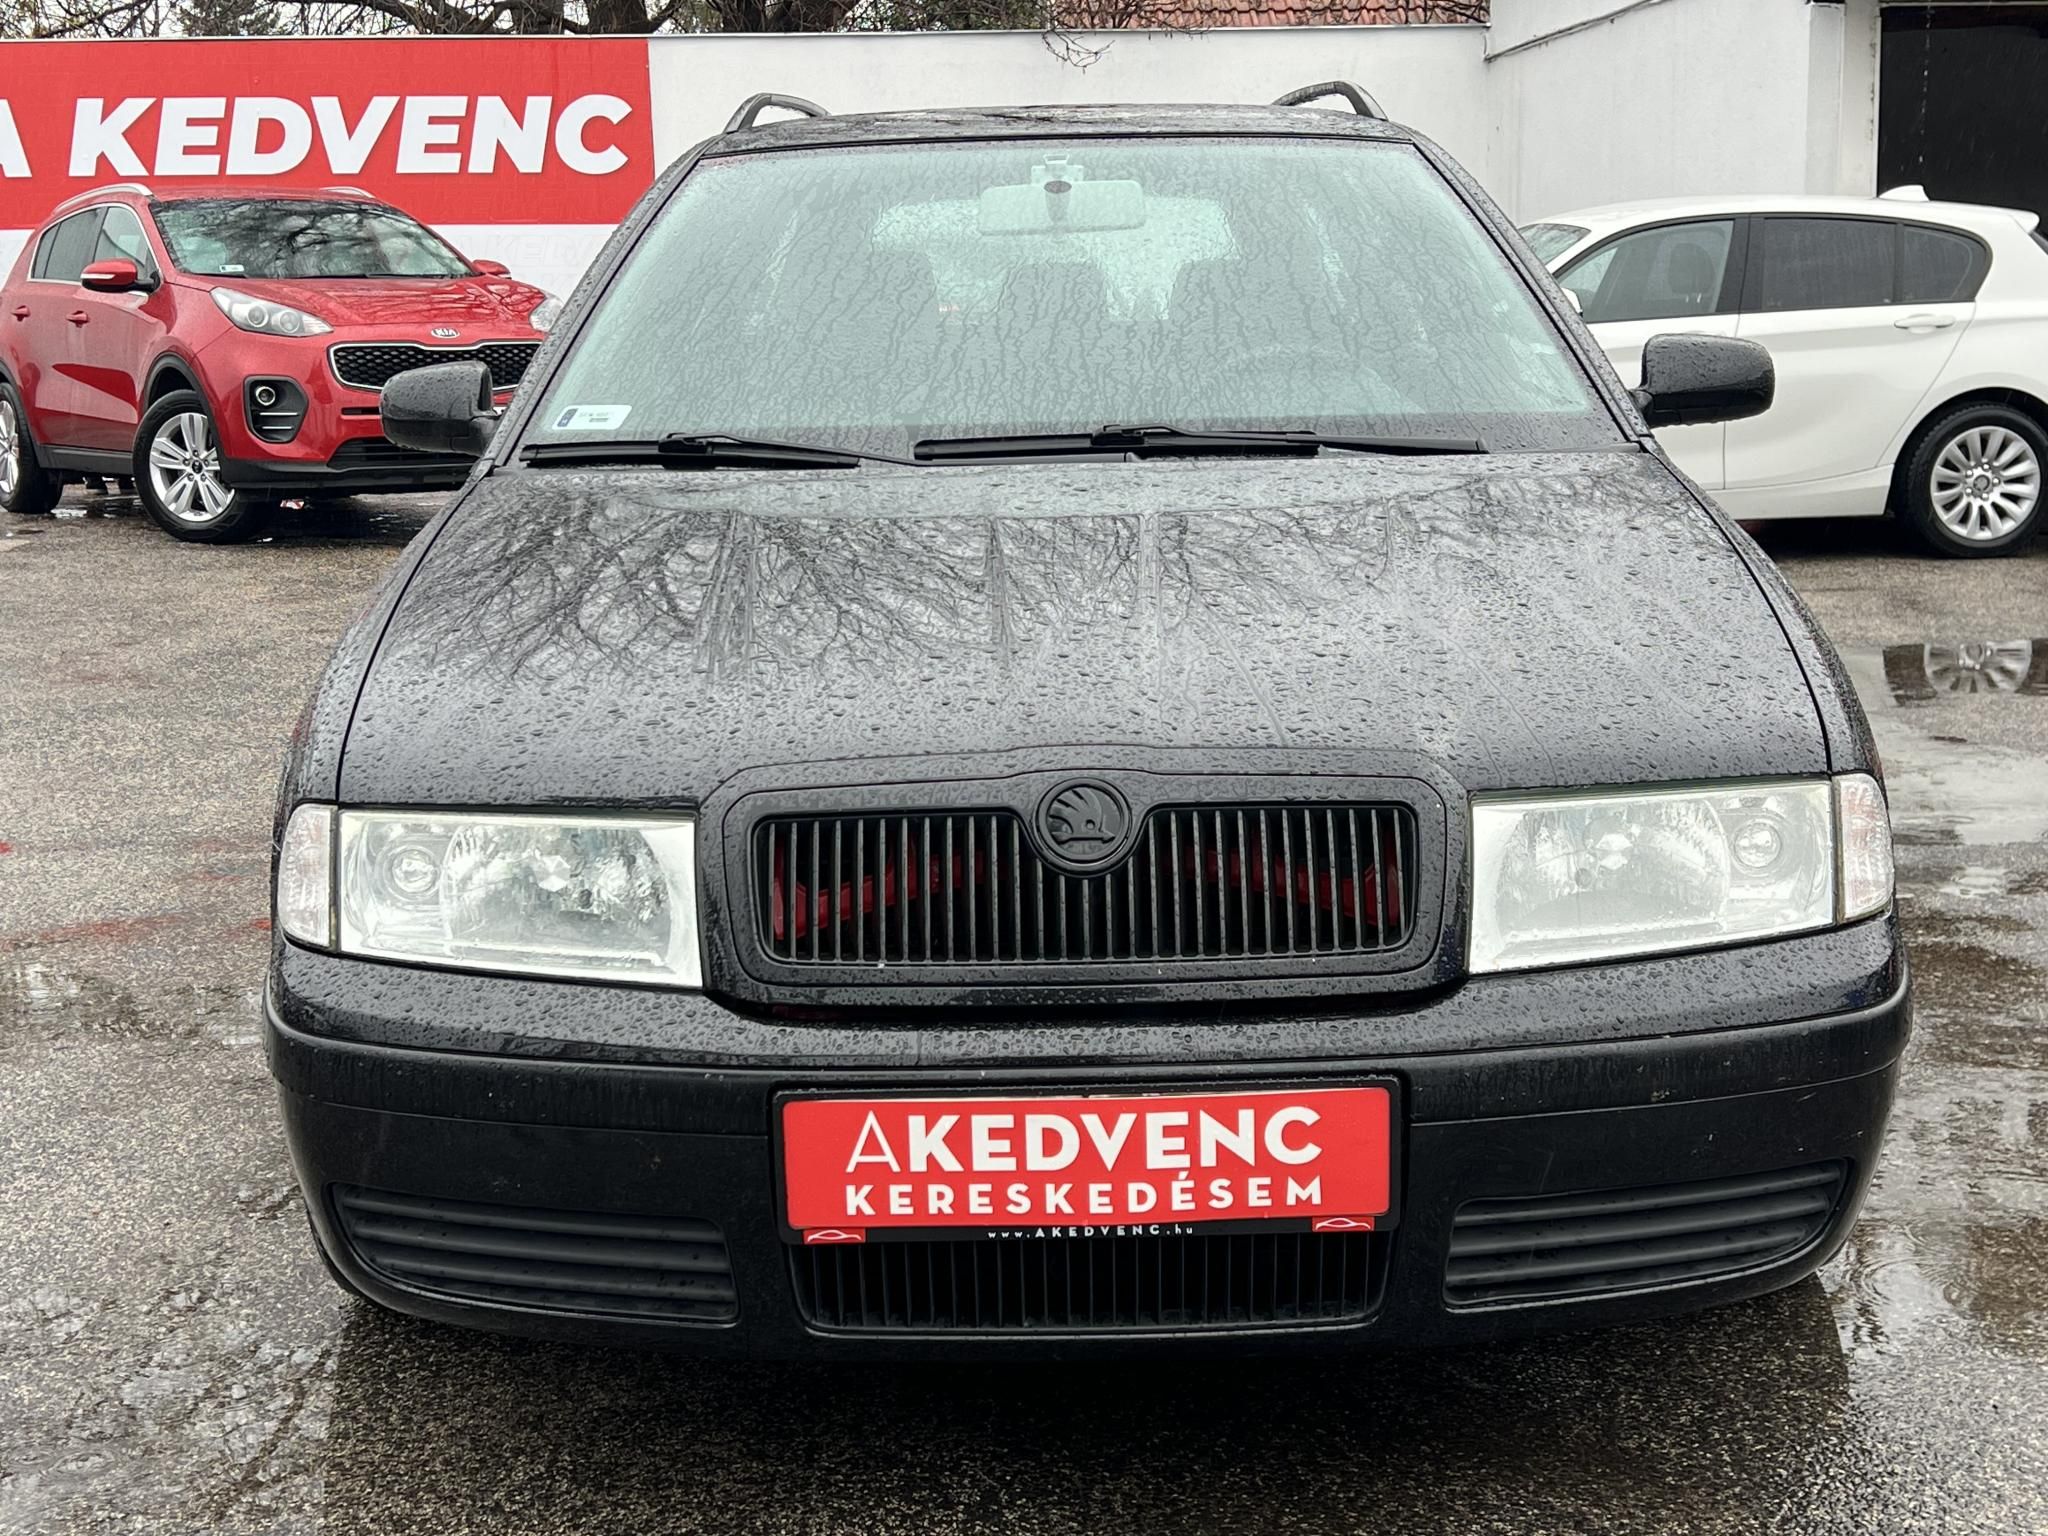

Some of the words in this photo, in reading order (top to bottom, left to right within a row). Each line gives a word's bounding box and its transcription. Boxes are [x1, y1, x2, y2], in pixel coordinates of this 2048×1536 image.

[68, 94, 633, 177] KEDVENC
[433, 328, 459, 338] KIA
[846, 1170, 1324, 1217] KERESKEDÉSEM
[987, 1223, 1193, 1239] www.AKEDVENC.hu
